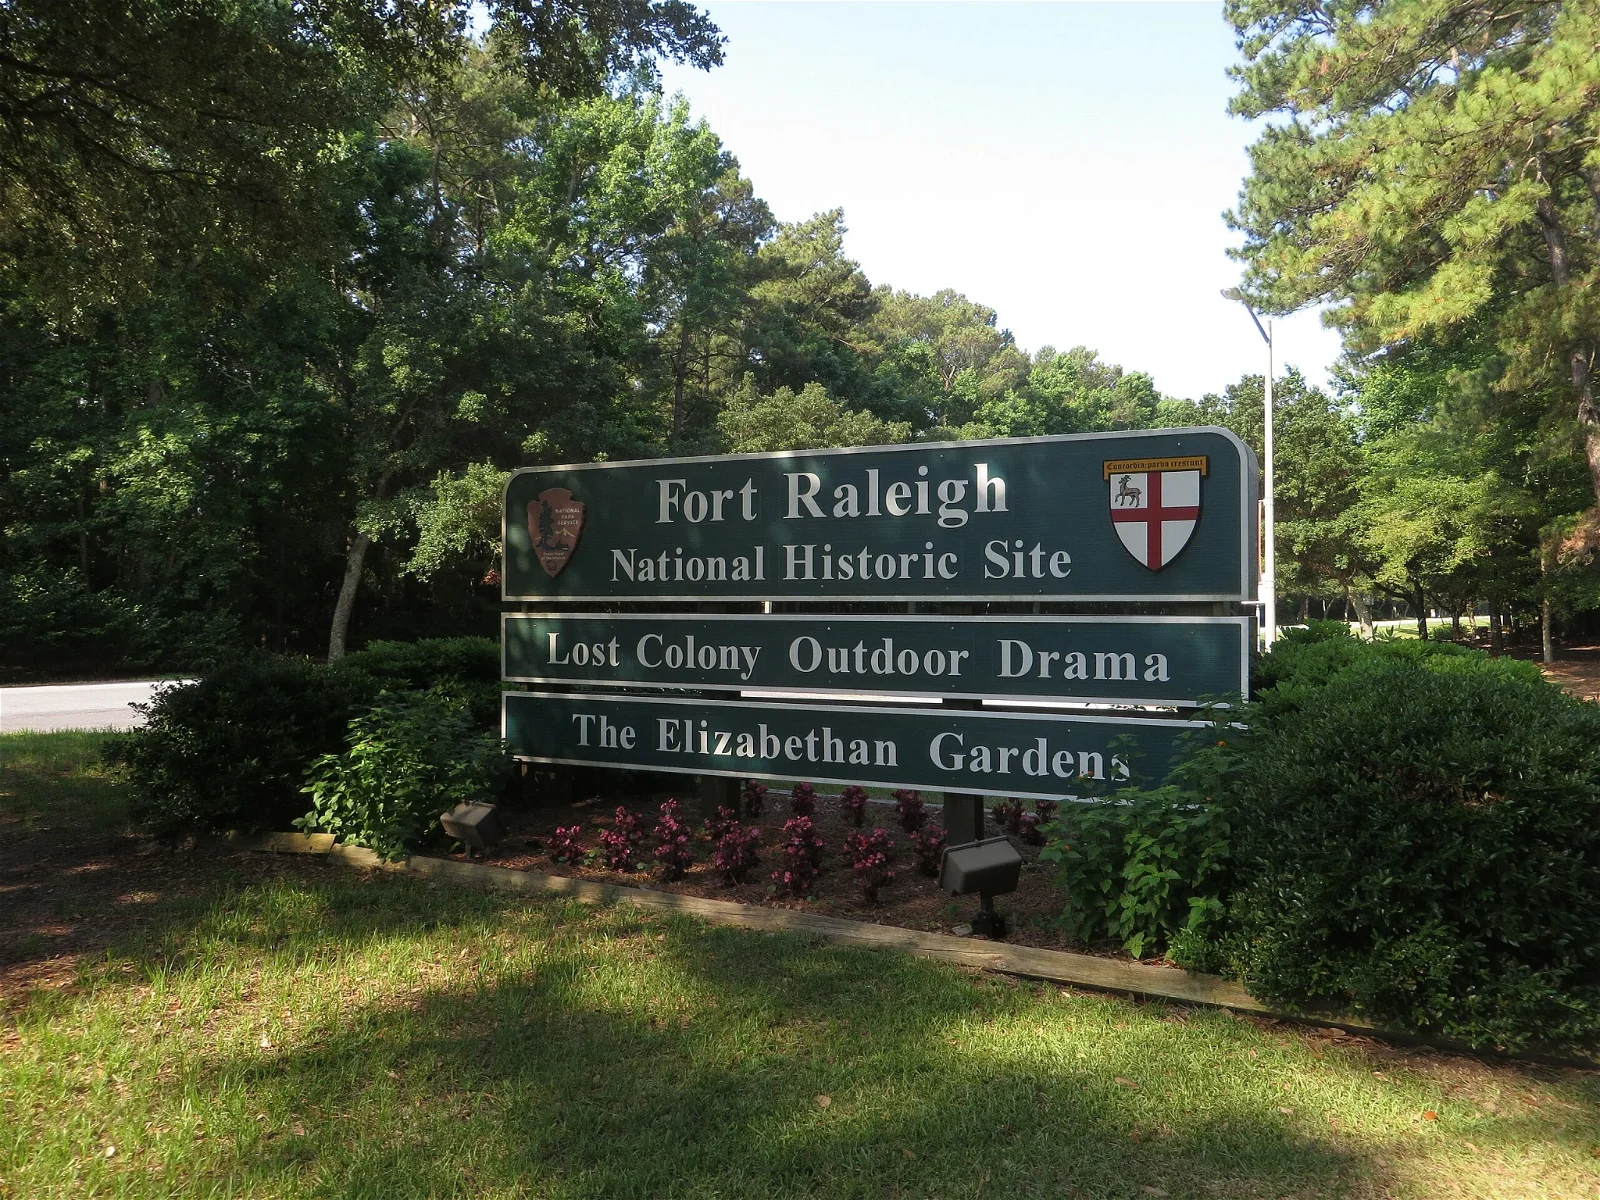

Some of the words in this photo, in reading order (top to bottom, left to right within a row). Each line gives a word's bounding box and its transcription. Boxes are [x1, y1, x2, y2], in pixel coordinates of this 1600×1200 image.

[655, 478, 757, 524] Fort
[783, 463, 1010, 529] Raleigh
[610, 545, 766, 582] National
[783, 543, 959, 581] Historic
[984, 540, 1072, 579] Site
[547, 631, 621, 667] Lost
[636, 633, 762, 681] Colony
[788, 635, 970, 677] Outdoor
[997, 638, 1170, 682] Drama
[571, 713, 636, 750] The
[656, 718, 899, 768] Elizabethan
